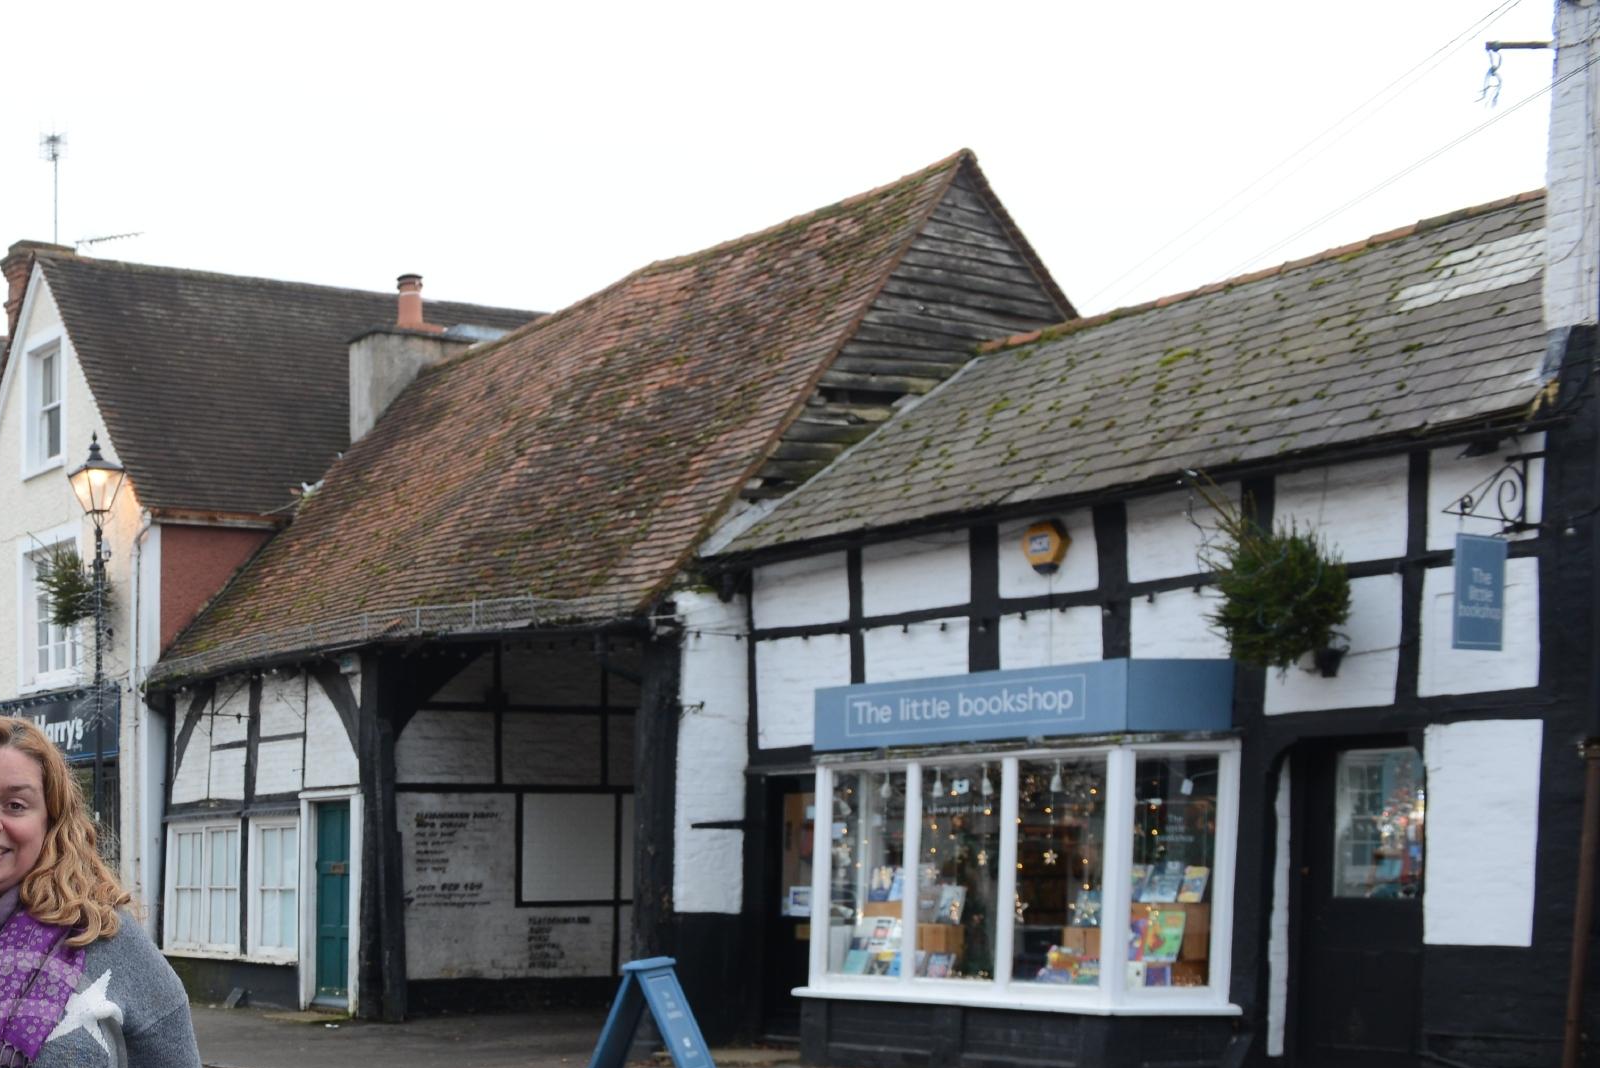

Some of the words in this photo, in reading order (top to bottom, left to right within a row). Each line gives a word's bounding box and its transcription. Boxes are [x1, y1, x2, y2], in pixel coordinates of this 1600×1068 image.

[853, 701, 892, 725] The
[899, 697, 950, 721] little
[958, 686, 1074, 717] bookshop
